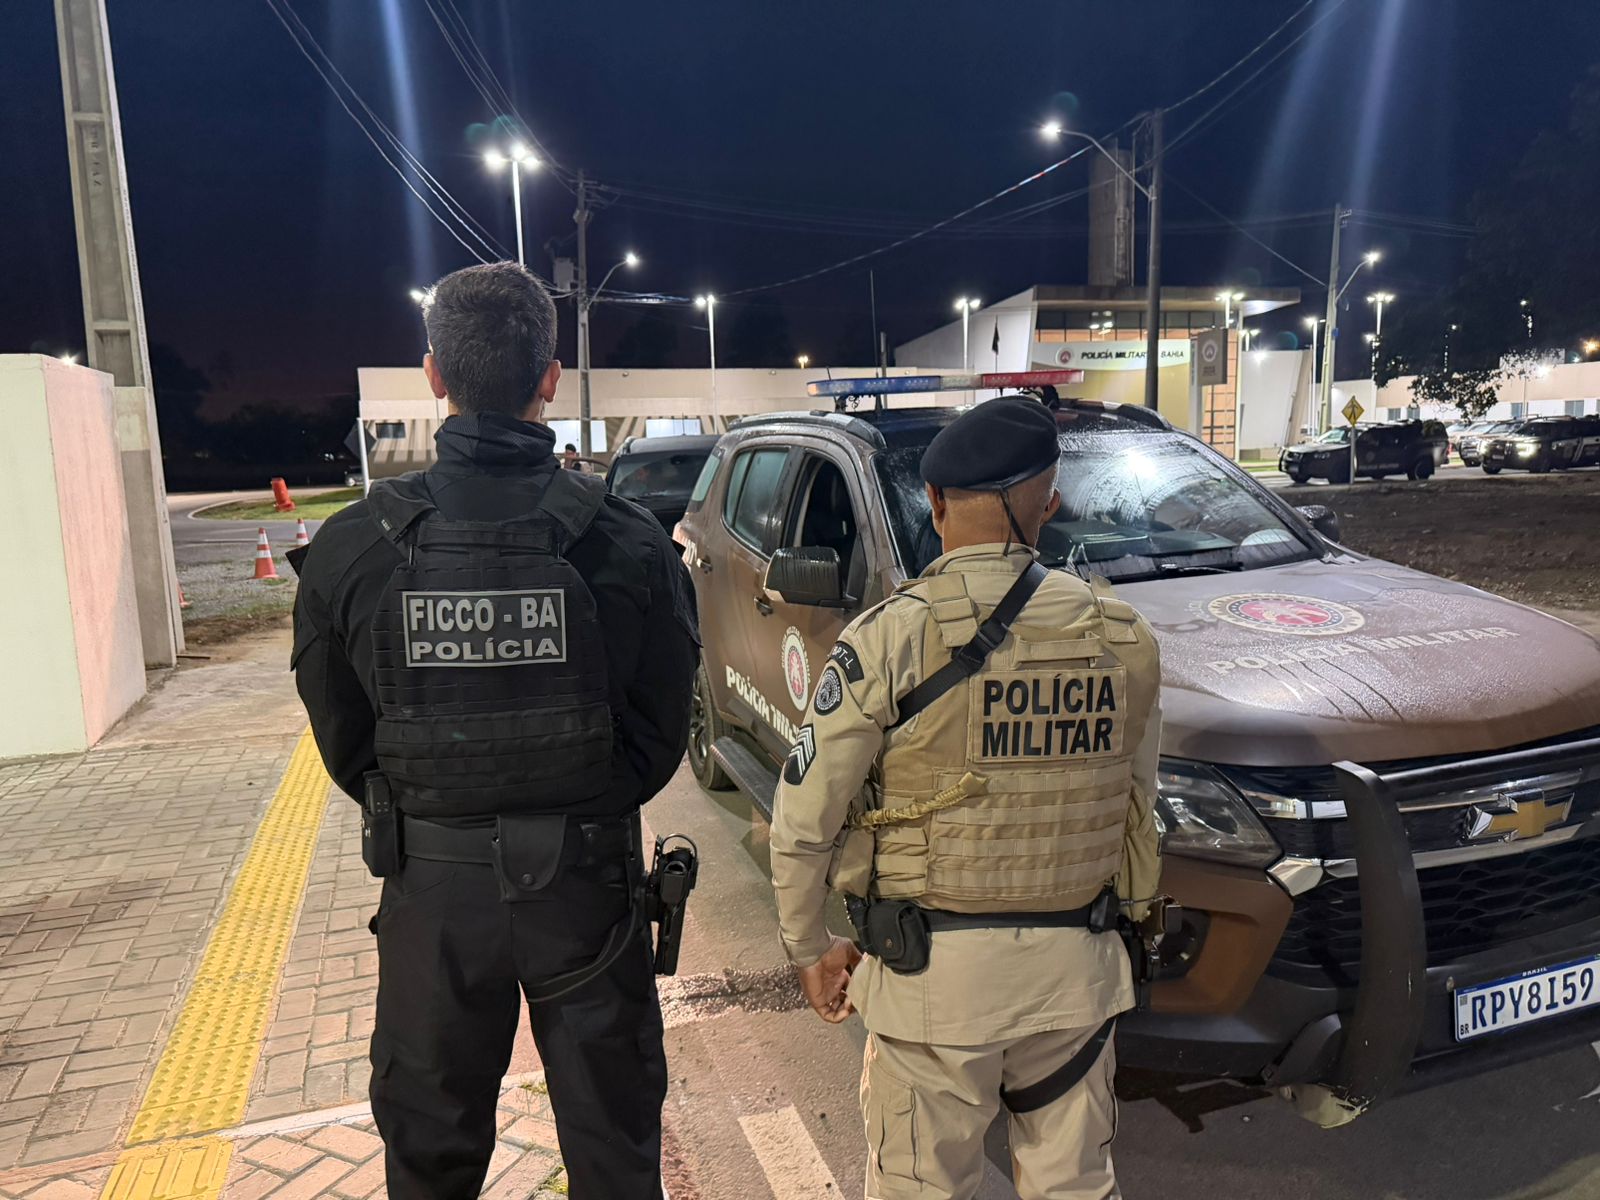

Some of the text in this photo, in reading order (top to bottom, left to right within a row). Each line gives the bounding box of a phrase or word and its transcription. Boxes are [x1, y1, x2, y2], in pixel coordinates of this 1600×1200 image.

[1081, 348, 1113, 360] POLÍCIA
[1115, 351, 1147, 359] MILITAR
[409, 598, 495, 632] FICCO
[520, 596, 559, 629] BA
[411, 637, 560, 661] POLÍCIA
[1370, 627, 1521, 651] MILITAR
[725, 664, 770, 724] POLÍCIA
[983, 673, 1116, 717] POLÍCIA
[982, 717, 1113, 757] MILITAR
[1471, 967, 1594, 1030] RPY8I59
[1460, 1023, 1470, 1036] BR
